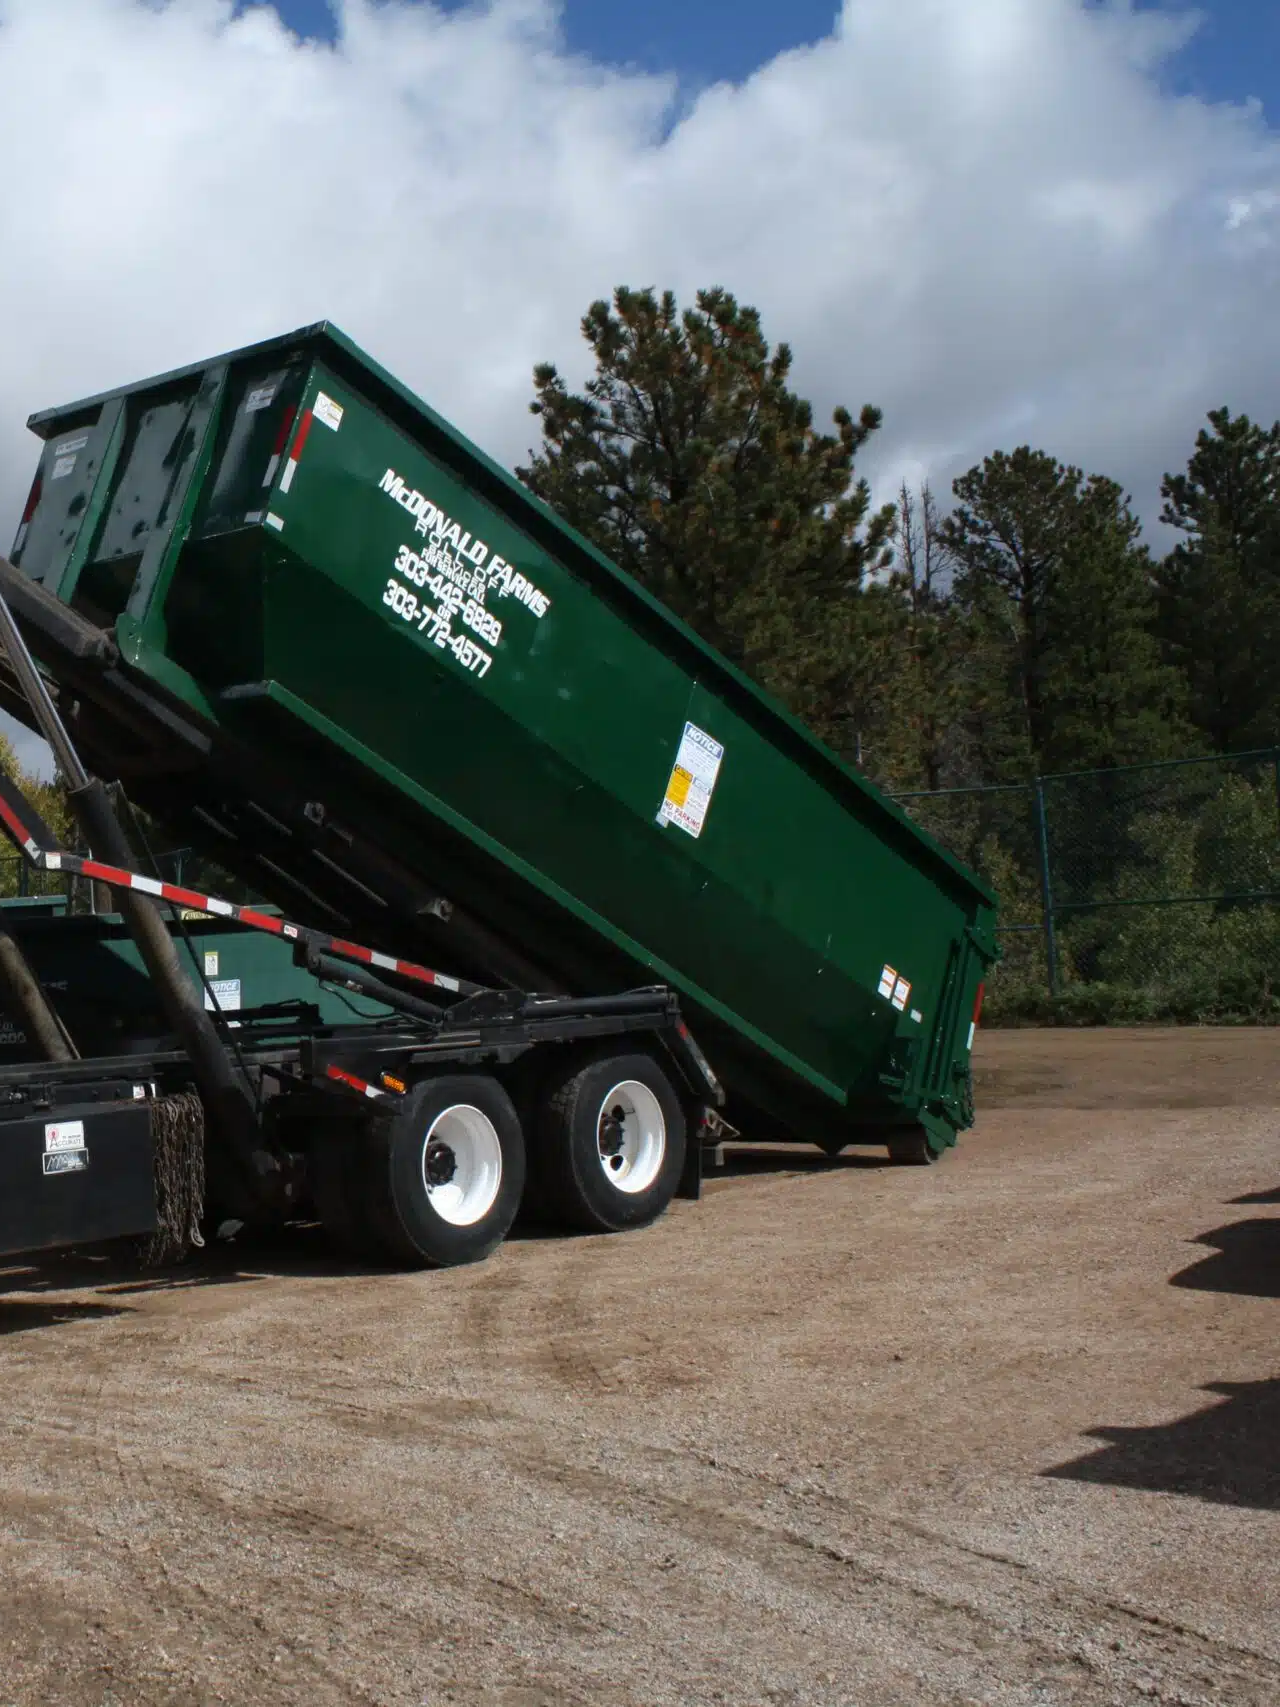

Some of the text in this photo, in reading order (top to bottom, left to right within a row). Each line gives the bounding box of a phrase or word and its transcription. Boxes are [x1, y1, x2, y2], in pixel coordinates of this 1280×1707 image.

[378, 468, 551, 619] McDONALD FARMS
[414, 519, 510, 599] ROLL OFF
[394, 544, 502, 647] 303-442-6829
[437, 603, 452, 622] OR
[382, 579, 492, 678] 303-772-4577
[686, 726, 720, 757] NOTICE
[674, 806, 700, 829] PARKING
[211, 981, 237, 992] OTICE
